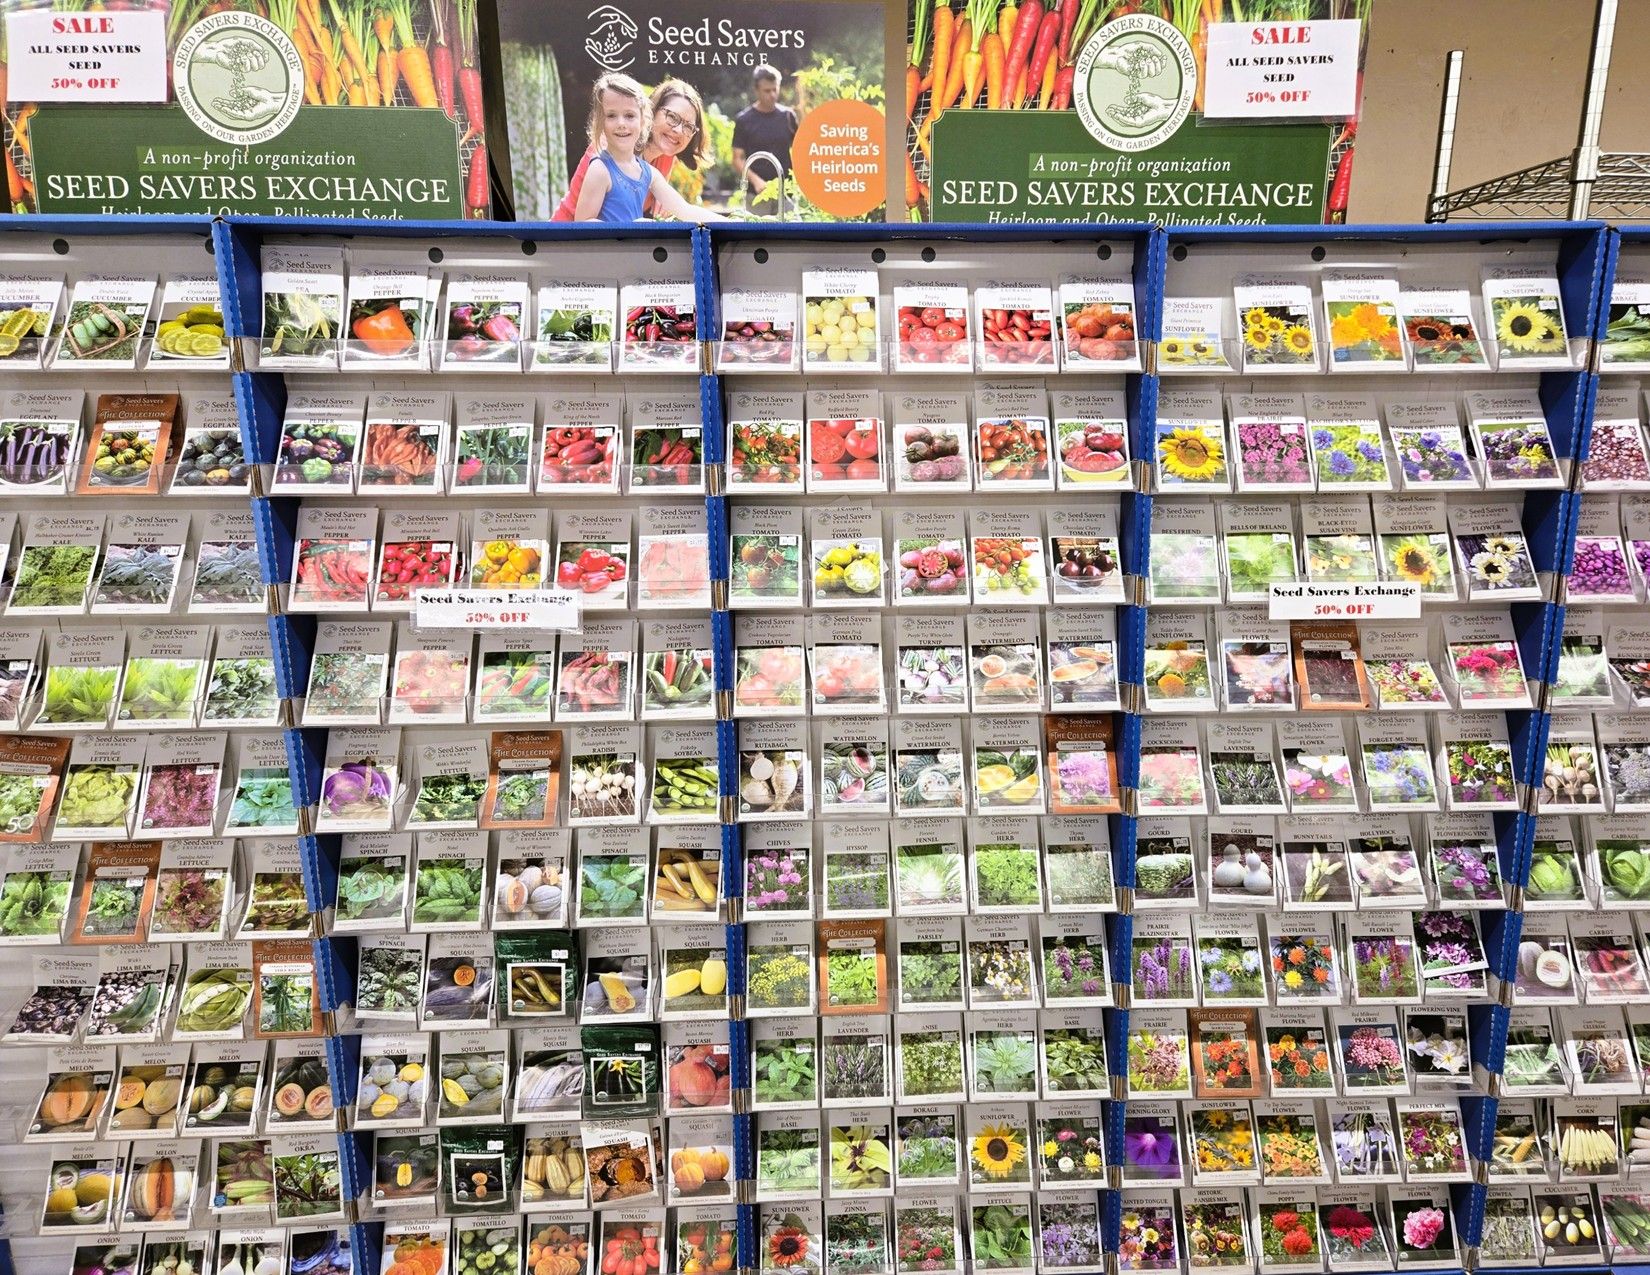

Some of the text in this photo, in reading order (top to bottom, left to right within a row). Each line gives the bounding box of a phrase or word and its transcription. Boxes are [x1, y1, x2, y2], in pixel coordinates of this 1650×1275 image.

[51, 17, 115, 34] SALE
[648, 17, 805, 49] Seed Savers
[1250, 25, 1312, 46] SALE
[176, 36, 196, 69] SEED
[194, 14, 239, 37] SAVERS
[1078, 40, 1100, 75] SEED
[1099, 17, 1144, 41] SAVERS
[28, 43, 141, 54] ALL SEED SAVERS
[648, 49, 769, 67] EXCHANGE
[1226, 54, 1334, 67] ALL SEED SAVERS
[68, 60, 102, 71] SEED
[51, 77, 120, 90] 50% OFF
[1263, 73, 1295, 83] SEED
[1245, 90, 1312, 104] 50% OFF
[178, 85, 202, 122] PASSING
[202, 120, 215, 133] ON
[216, 129, 235, 142] OUR
[238, 127, 275, 142] GARDEN
[1076, 92, 1095, 128] PASSING
[1094, 127, 1106, 140] ON
[1106, 136, 1123, 148] OUR
[1126, 134, 1161, 150] GARDEN
[819, 123, 868, 141] Saving
[808, 141, 880, 157] America's
[143, 147, 356, 171] A non-profit organization
[811, 159, 878, 175] Heirloom
[1033, 154, 1231, 178] A non-profit organization
[46, 174, 450, 203] SEED SAVERS EXCHANGE
[823, 177, 866, 193] Seeds
[942, 181, 1314, 208] SEED SAVERS EXCHANGE
[286, 260, 332, 270] Seed Savers
[1173, 301, 1213, 310] Seed Savers
[28, 393, 72, 402] Seed Savers
[567, 400, 585, 408] Seed
[324, 511, 367, 519] Seed Savers
[1273, 585, 1416, 597] Seed Savers Exchange
[420, 593, 453, 604] Seed
[1314, 604, 1375, 615] 50% OFF
[465, 612, 530, 623] 50% OFF
[6, 813, 35, 834] 50
[69, 1064, 94, 1072] MELON
[980, 1113, 1015, 1121] SUNFLOWER
[294, 1144, 316, 1153] OKRA
[772, 1205, 810, 1213] SUNFLOWER
[844, 1205, 867, 1213] ZINNIA
[404, 1224, 430, 1232] TOMATO
[472, 1219, 507, 1227] TOMATILLO
